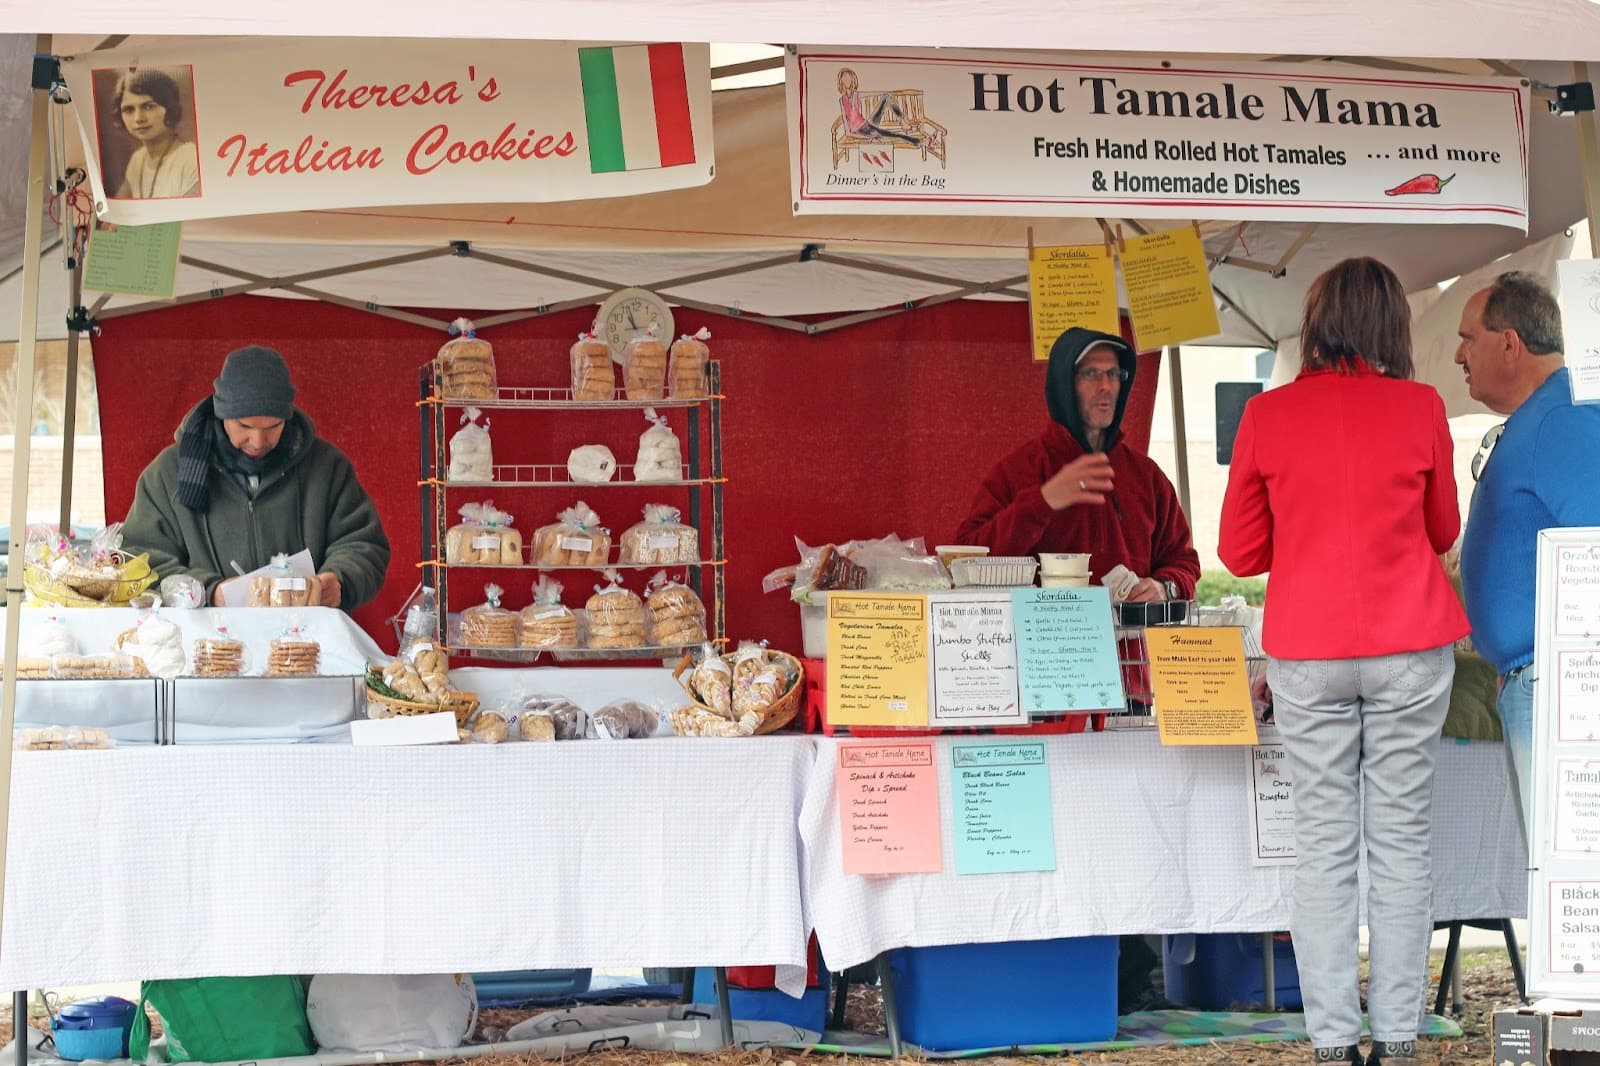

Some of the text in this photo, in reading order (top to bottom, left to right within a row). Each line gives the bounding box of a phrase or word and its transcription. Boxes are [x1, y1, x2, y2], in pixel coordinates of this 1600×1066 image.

[284, 65, 501, 114] Theresa's
[968, 72, 1441, 129] Hot Tamale Mama
[217, 122, 578, 177] Italian Cookies
[1034, 137, 1347, 166] Fresh Hand Rolled Hot Tamales
[1398, 144, 1439, 161] and
[1445, 147, 1501, 164] more
[826, 174, 946, 190] Dinner's in the Bag
[1092, 170, 1301, 195] & Homemade Dishes
[1050, 248, 1089, 260] Skordalia
[632, 301, 641, 312] 12
[614, 313, 623, 323] 10
[610, 323, 616, 333] 9
[613, 334, 619, 343] 8
[1562, 551, 1588, 560] Orzo
[1036, 590, 1081, 602] Skordalia
[872, 602, 895, 610] Tamale
[937, 633, 1012, 646] Jumbo Stuffed
[1170, 634, 1213, 645] Hummus
[961, 649, 992, 662] Shells
[1568, 657, 1600, 668] Spina
[1581, 682, 1599, 693] Dip
[1255, 750, 1269, 759] Hot
[850, 772, 876, 781] Spinach
[886, 771, 916, 779] Artichoke
[861, 784, 907, 793] Dip Spread
[1259, 791, 1289, 801] Roasted
[1562, 888, 1600, 900] Black
[1563, 905, 1599, 917] Bean
[1562, 921, 1600, 934] Salsa
